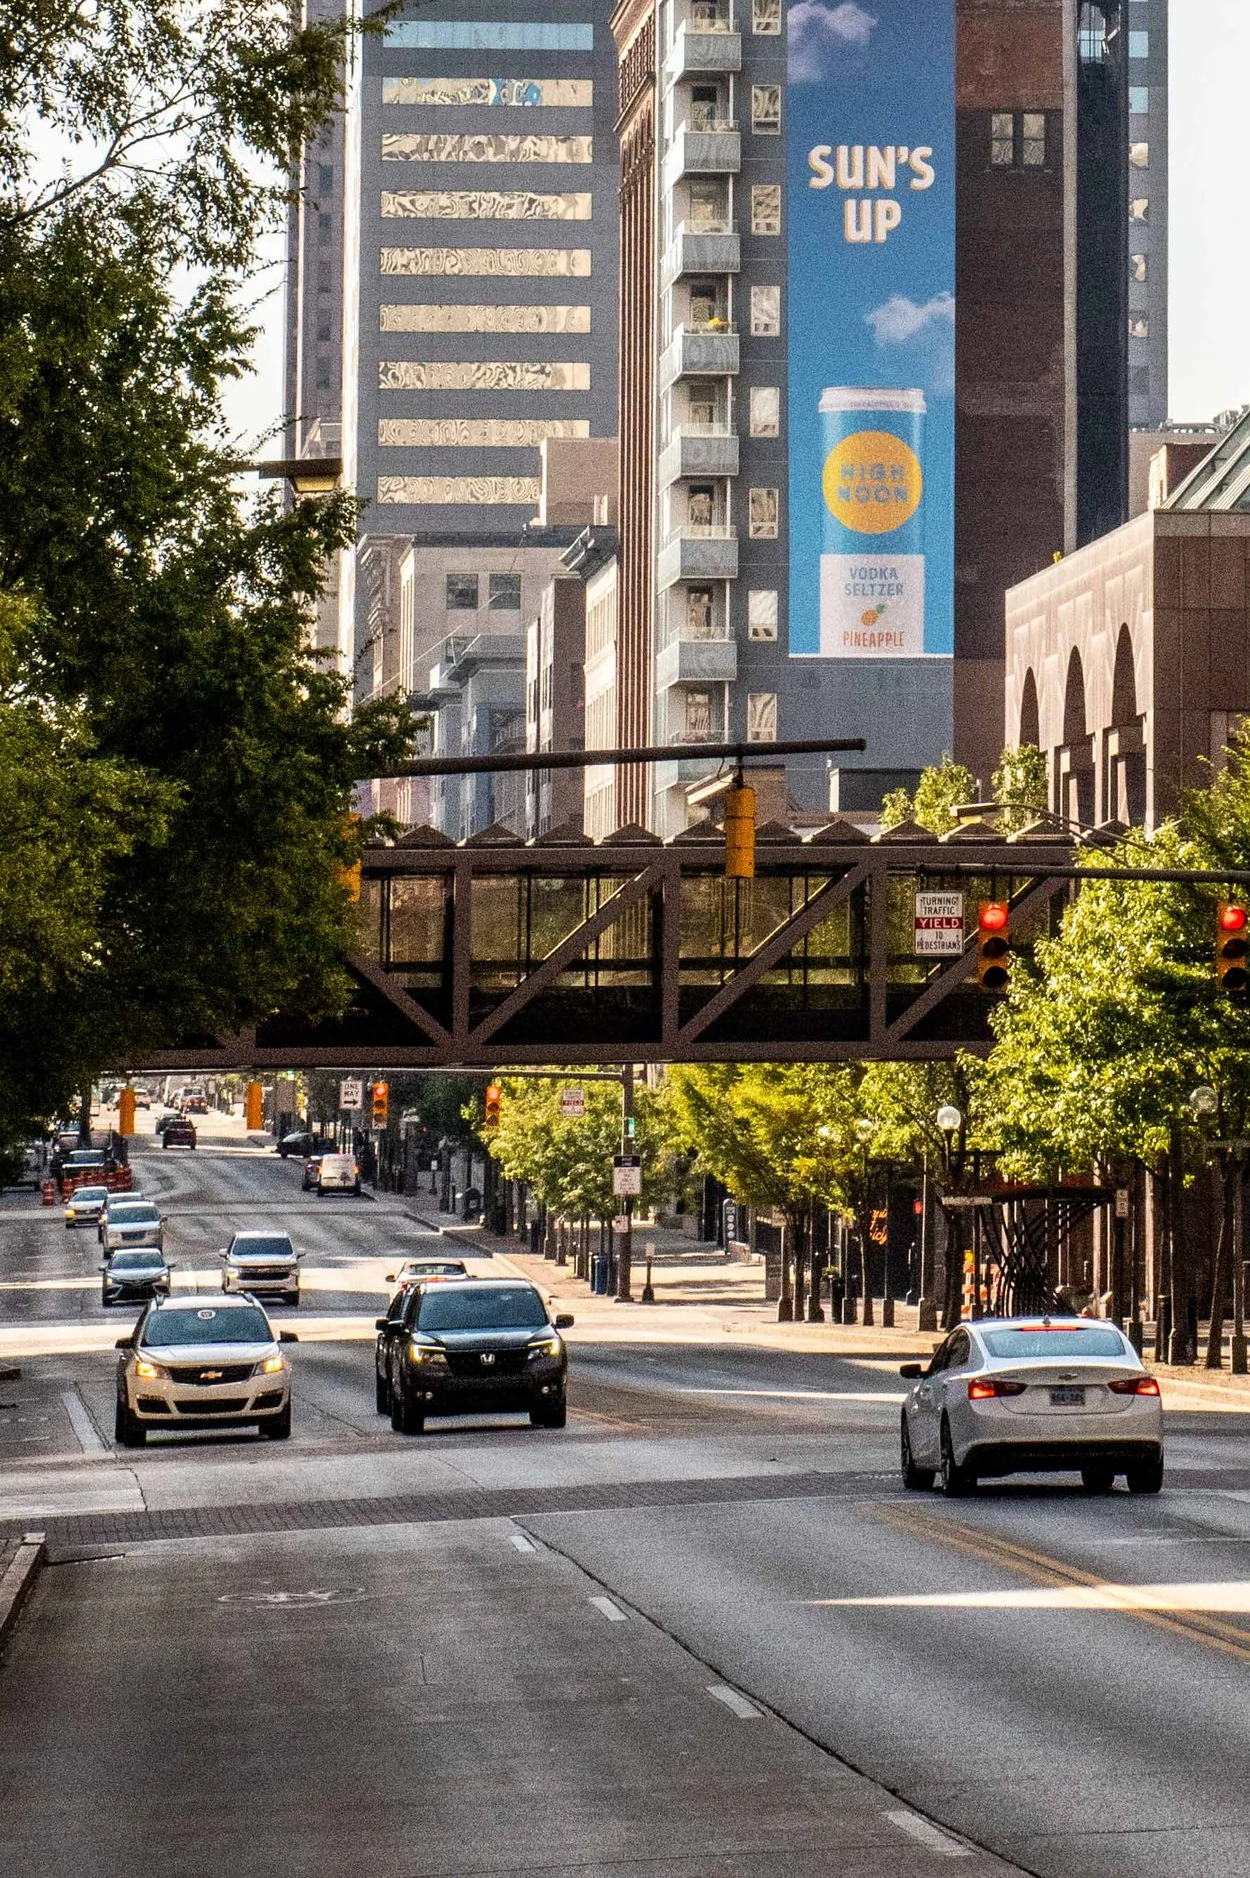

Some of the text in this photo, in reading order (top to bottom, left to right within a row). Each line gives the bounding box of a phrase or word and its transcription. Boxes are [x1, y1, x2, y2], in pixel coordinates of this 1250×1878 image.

[807, 144, 936, 191] SUN'S
[843, 198, 902, 243] UP
[840, 463, 905, 480] HIGH
[837, 485, 909, 503] NOON
[849, 566, 898, 580] VODKA
[844, 582, 904, 596] SELTZER
[843, 630, 905, 647] PINEAPPLE
[921, 896, 957, 905] TURNING
[923, 906, 955, 915] TRAFFIC
[919, 918, 960, 928] YIELD
[935, 931, 944, 939] TO
[916, 940, 961, 950] PEDESTRIANS
